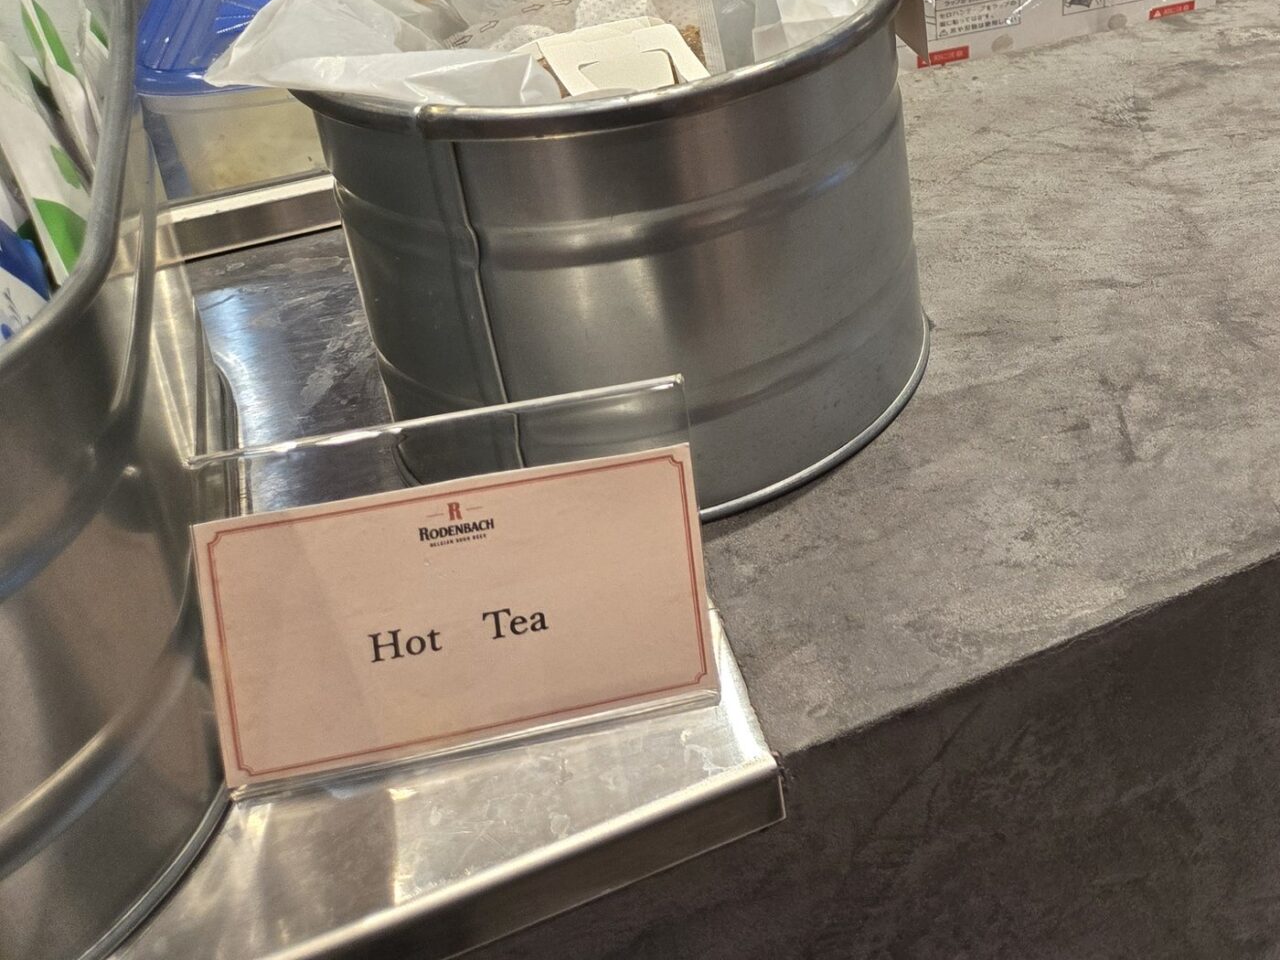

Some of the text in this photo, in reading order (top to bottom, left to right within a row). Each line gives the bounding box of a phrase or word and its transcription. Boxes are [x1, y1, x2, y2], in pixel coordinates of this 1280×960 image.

[447, 502, 462, 521] R
[418, 518, 495, 541] RODENBACH
[368, 608, 549, 663] Hot Tea
